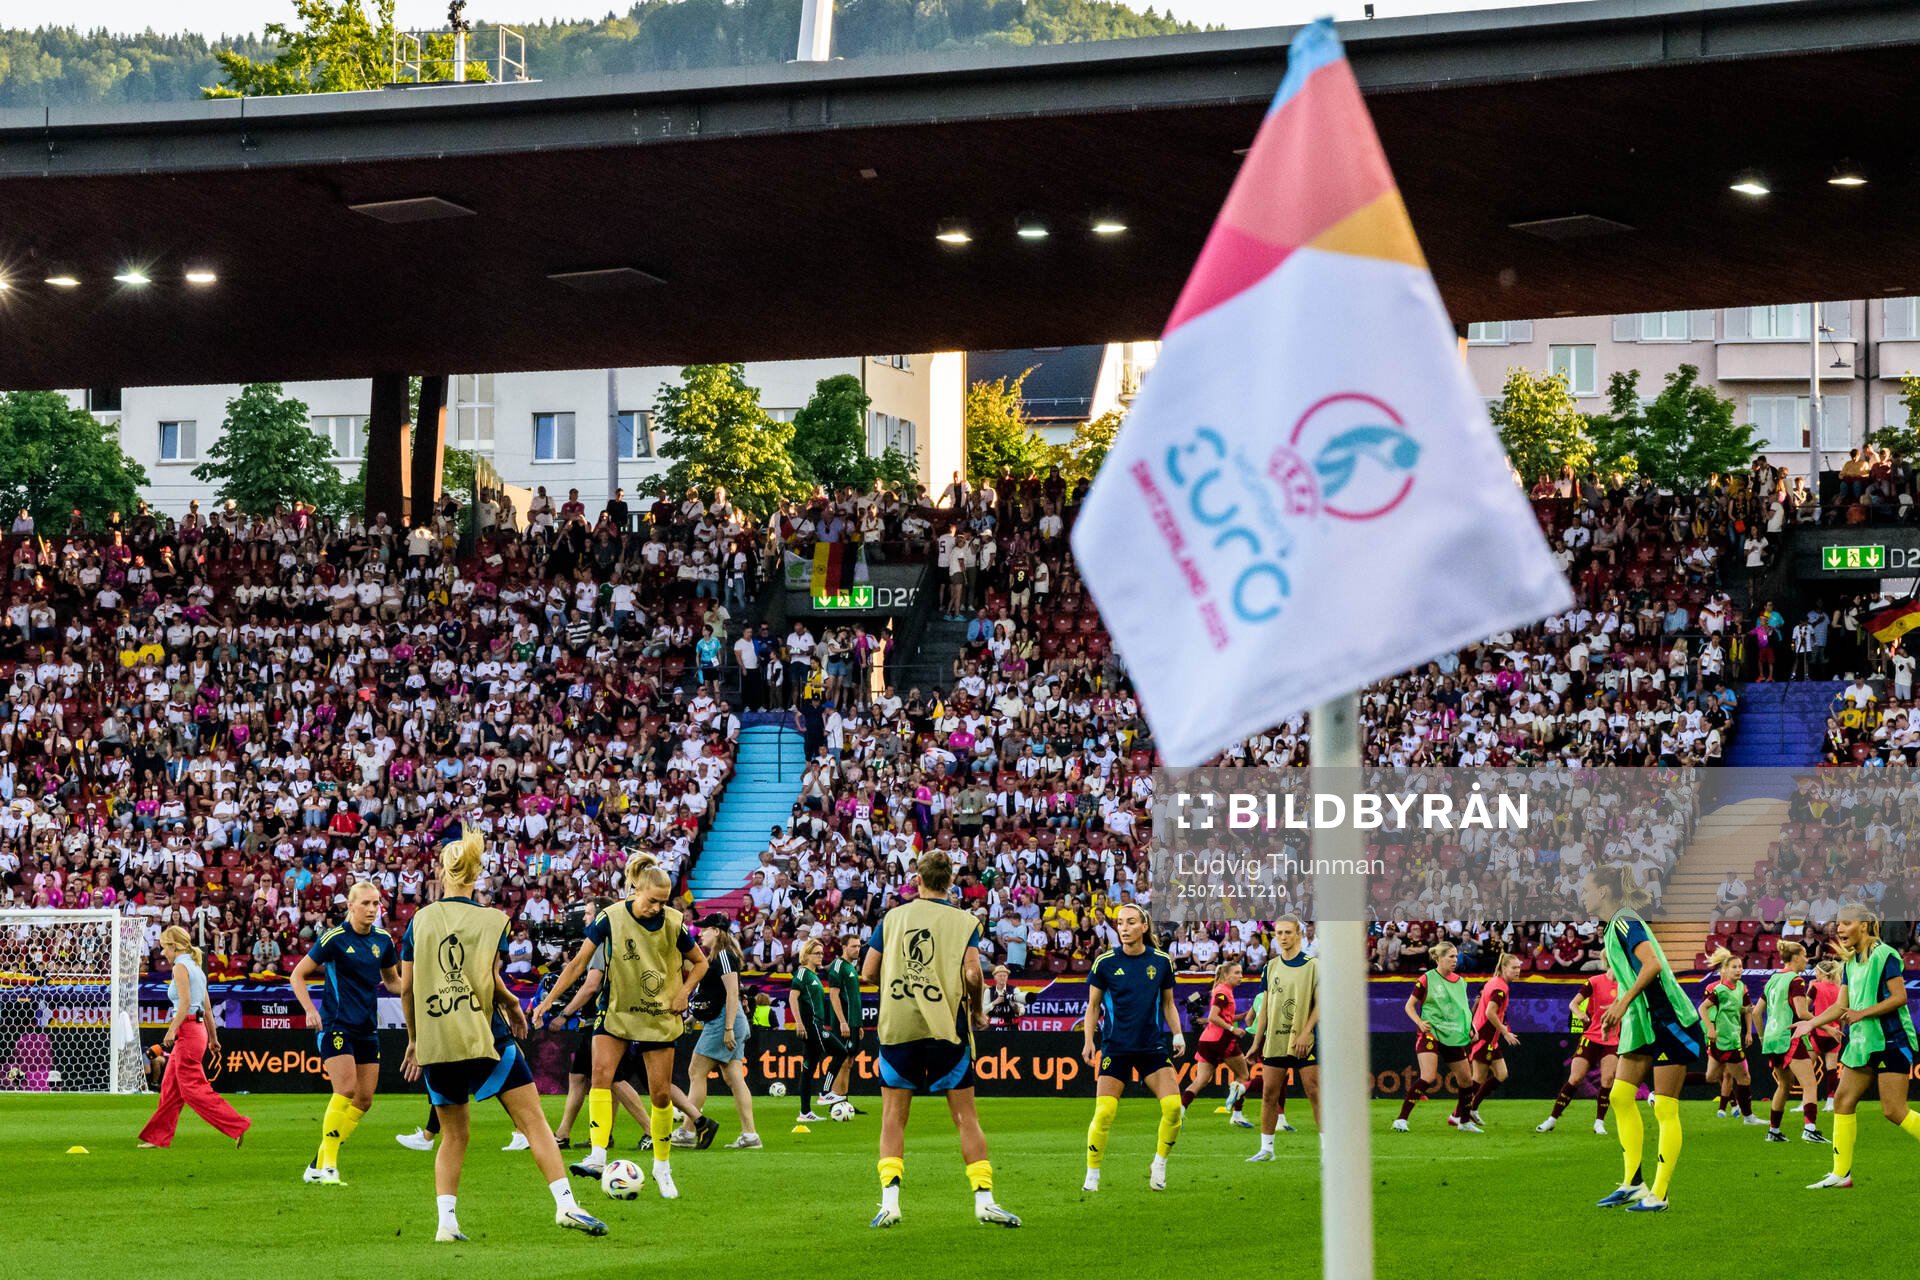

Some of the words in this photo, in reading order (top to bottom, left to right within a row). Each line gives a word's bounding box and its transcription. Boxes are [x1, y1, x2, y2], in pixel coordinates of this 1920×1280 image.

[1018, 571, 1025, 582] 8
[262, 1003, 288, 1014] SEKTION
[262, 1018, 290, 1029] LEIPZIG
[1018, 1020, 1063, 1031] DLER
[1033, 1057, 1079, 1090] up
